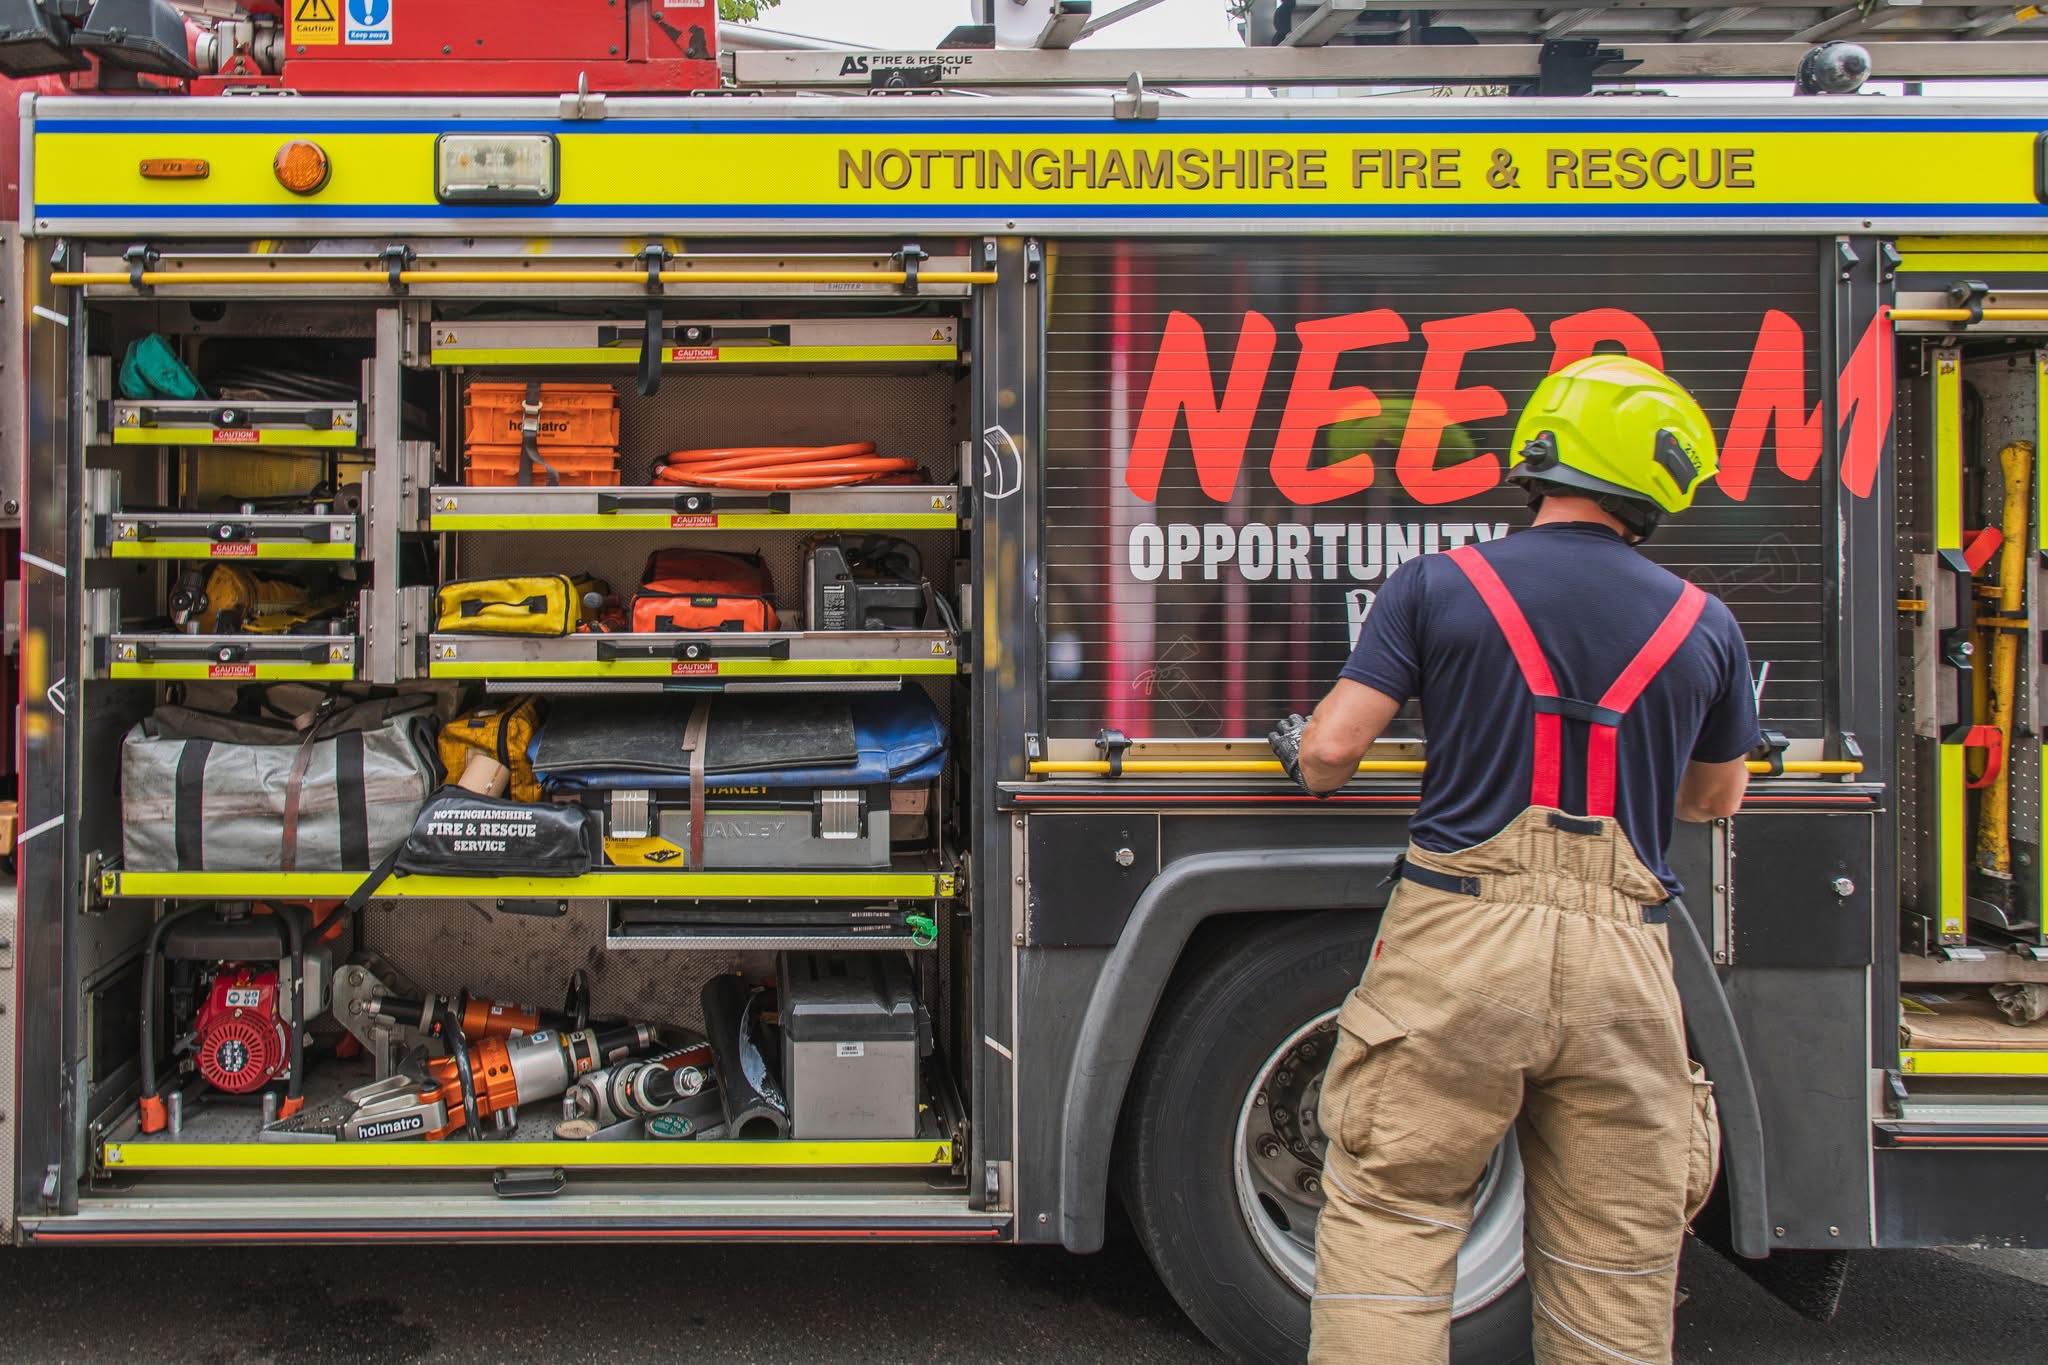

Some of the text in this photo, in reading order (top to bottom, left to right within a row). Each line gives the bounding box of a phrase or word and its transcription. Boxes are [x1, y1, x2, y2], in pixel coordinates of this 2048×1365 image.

[351, 31, 387, 40] Keep away
[872, 56, 973, 65] FIRE & RESCUE
[838, 147, 1755, 190] NOTTINGHAMSHIRE FIRE & RESCUE
[678, 349, 714, 357] CAUTION!
[1125, 308, 1665, 504] NEE
[509, 420, 568, 432] hoatro
[219, 431, 254, 439] CAUTION!
[216, 544, 252, 552] CAUTION!
[677, 663, 713, 671] CAUTION!
[433, 809, 533, 820] NOTTINGHAMSHIRE
[426, 822, 537, 837] FIRE & RESCUE
[687, 821, 785, 837] TANLEY
[453, 840, 506, 852] SERVICE
[358, 1118, 420, 1138] holmatro
